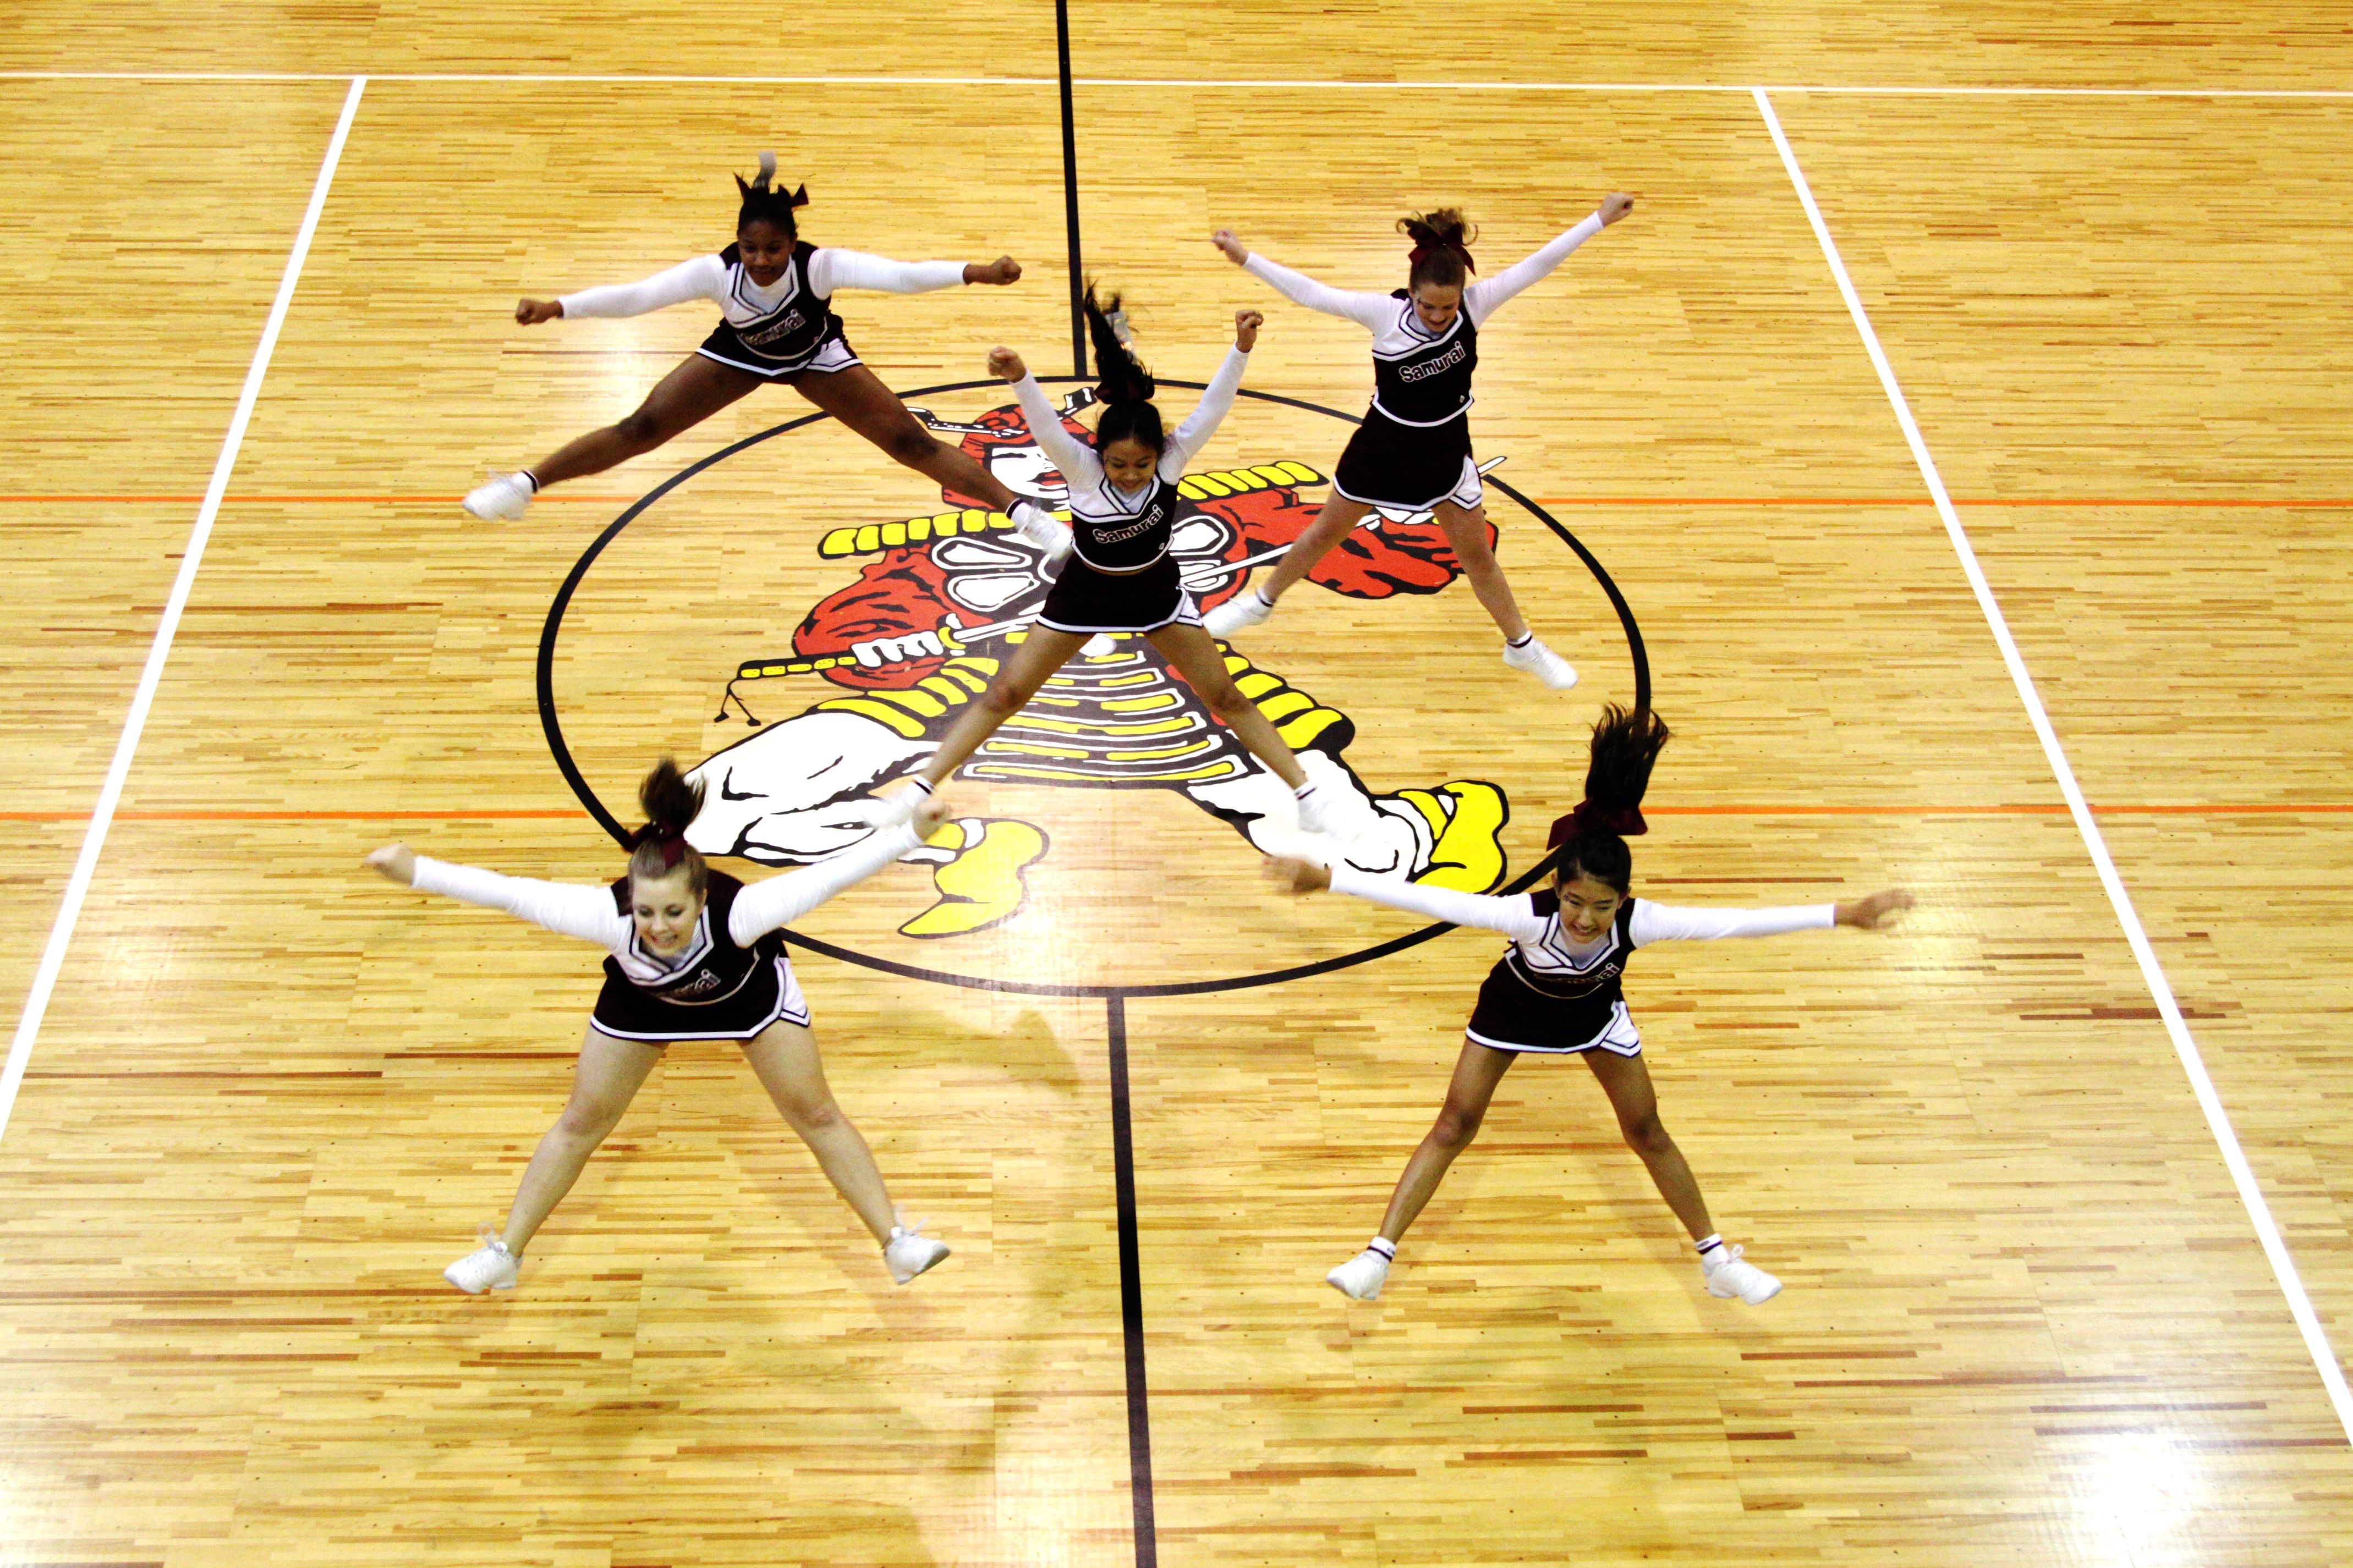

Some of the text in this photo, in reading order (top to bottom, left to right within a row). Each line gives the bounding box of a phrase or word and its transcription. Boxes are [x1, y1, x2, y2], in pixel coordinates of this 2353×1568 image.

[741, 309, 807, 346] urai
[1398, 340, 1466, 383] Samurai
[1093, 504, 1164, 544] Samurai
